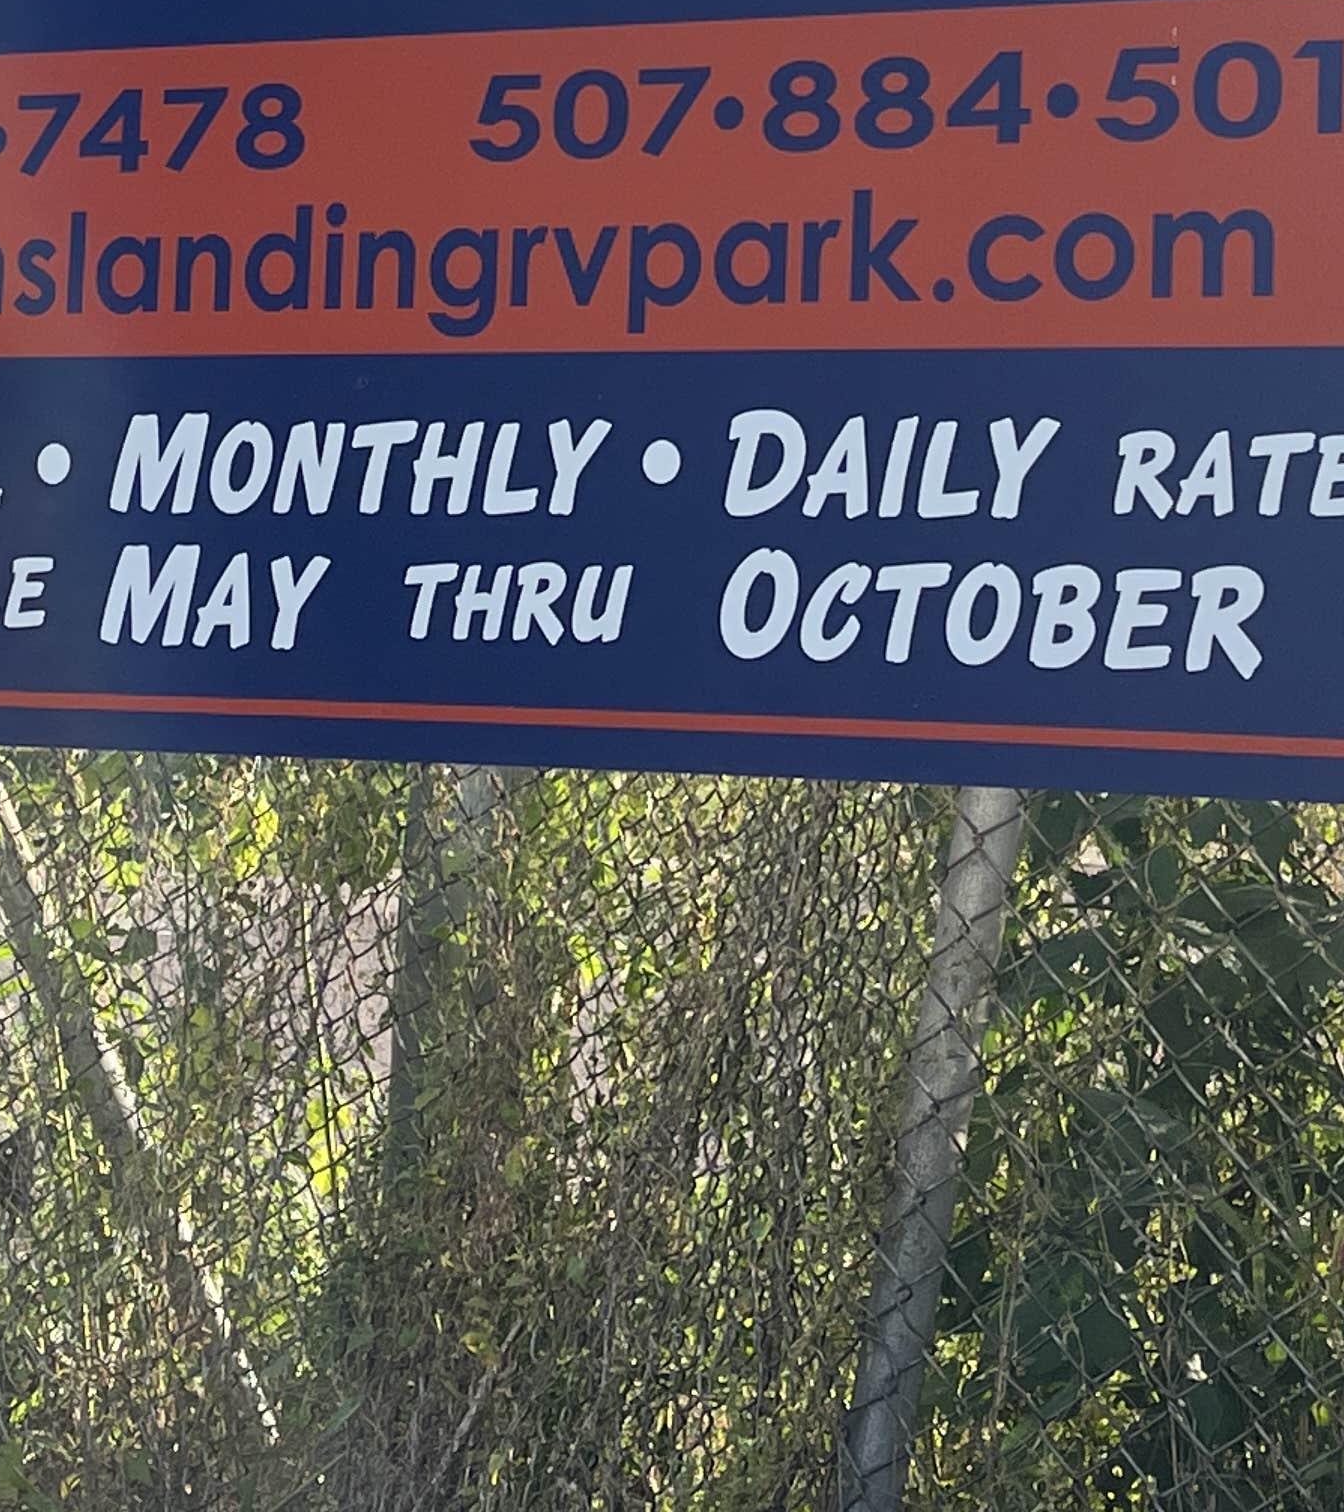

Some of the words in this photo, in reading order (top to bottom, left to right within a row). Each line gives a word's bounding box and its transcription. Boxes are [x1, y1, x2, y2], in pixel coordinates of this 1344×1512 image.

[110, 413, 612, 515] MONTHLY
[725, 410, 1060, 519] DAILY
[101, 545, 330, 649] MAY
[405, 562, 633, 645] THRU
[720, 548, 1264, 679] OCTOBER
